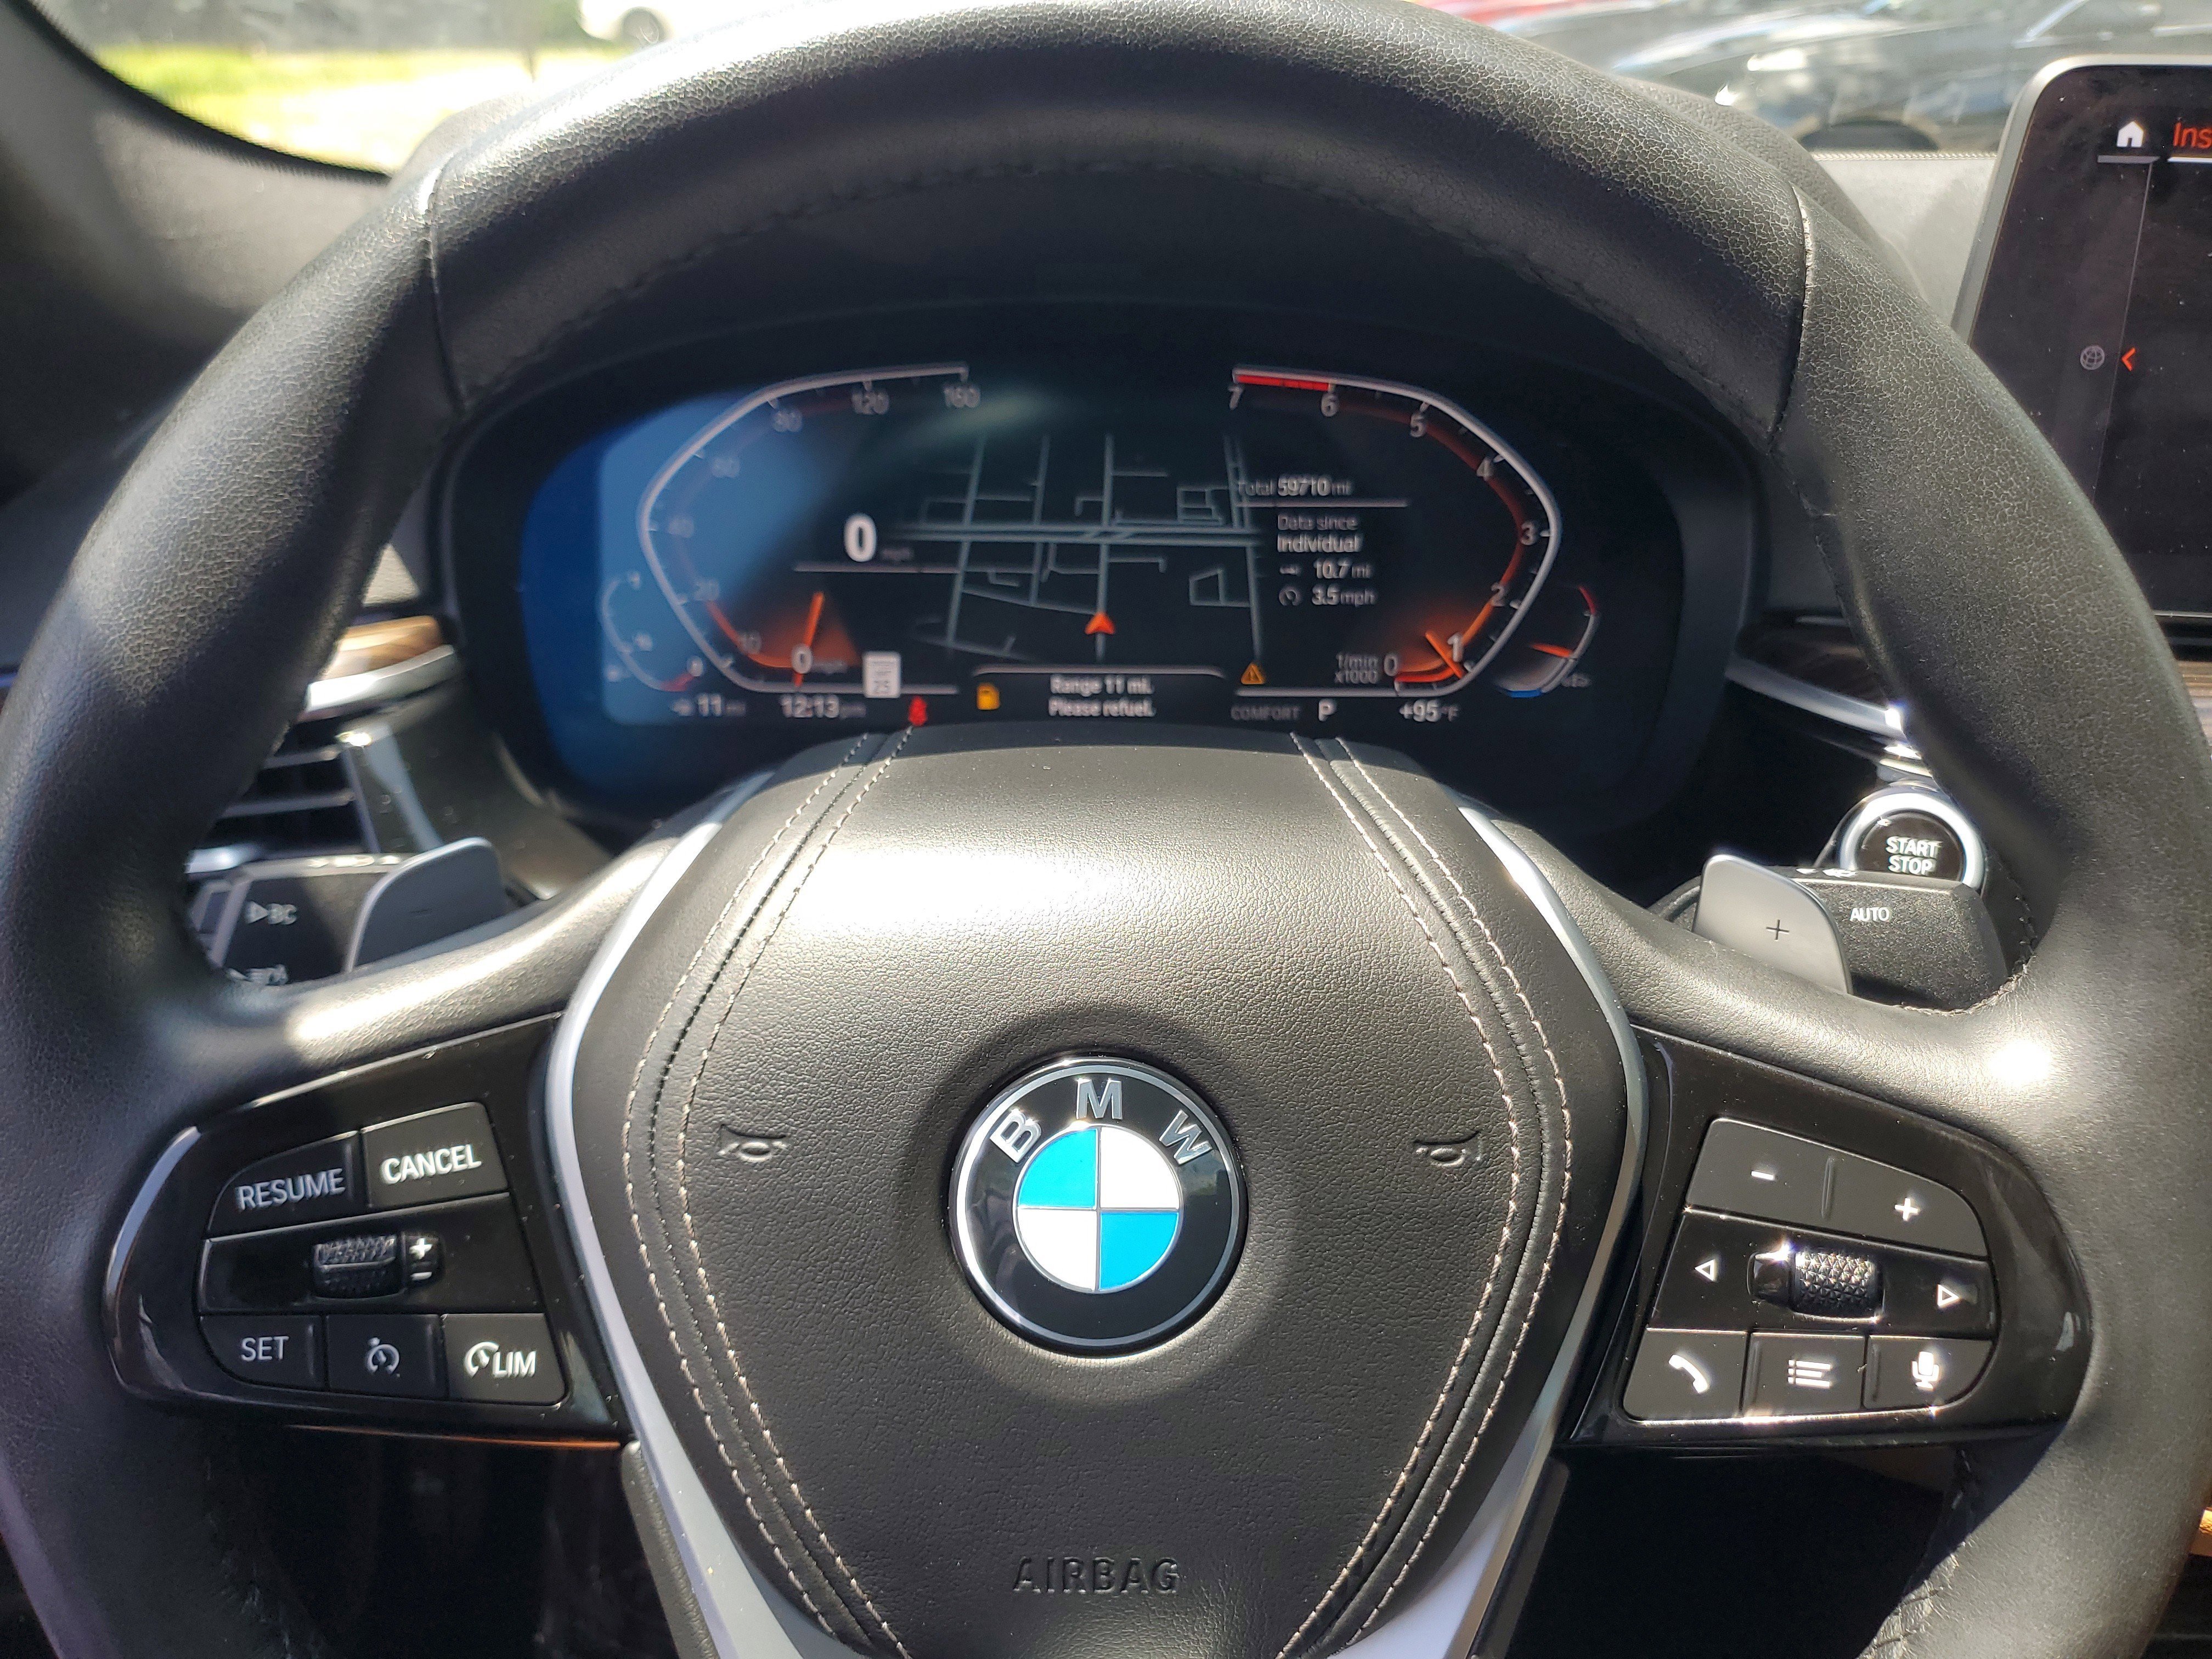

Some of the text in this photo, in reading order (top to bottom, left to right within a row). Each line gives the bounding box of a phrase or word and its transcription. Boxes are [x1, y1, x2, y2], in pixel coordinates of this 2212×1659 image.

[1228, 385, 1244, 410] 7
[1321, 396, 1340, 417] 6
[1410, 415, 1426, 437] 5
[1476, 460, 1494, 478] 4
[1238, 479, 1274, 496] Total
[1277, 475, 1331, 496] 59710
[1277, 514, 1358, 531] Data since
[1520, 522, 1537, 545] 3
[843, 512, 878, 563] 0
[1277, 533, 1362, 553] Individual
[1340, 588, 1377, 607] mph
[1491, 583, 1506, 607] 2
[791, 644, 814, 674] 0
[1447, 634, 1464, 662] 1
[1383, 655, 1398, 676] 0
[1050, 674, 1102, 697] Range
[1105, 675, 1125, 694] 11
[1048, 696, 1101, 716] Please
[1231, 704, 1300, 721] COMFORT
[1318, 699, 1337, 722] P
[1886, 835, 1943, 859] START
[1888, 855, 1937, 876] STOP
[1849, 906, 1892, 922] AUTO
[989, 1077, 1214, 1166] BMW
[381, 1143, 483, 1186] CANCEL
[235, 1166, 347, 1212] RESUME
[240, 1335, 290, 1363] SET
[492, 1350, 538, 1379] LIM
[1012, 1556, 1181, 1596] AIRBAG
